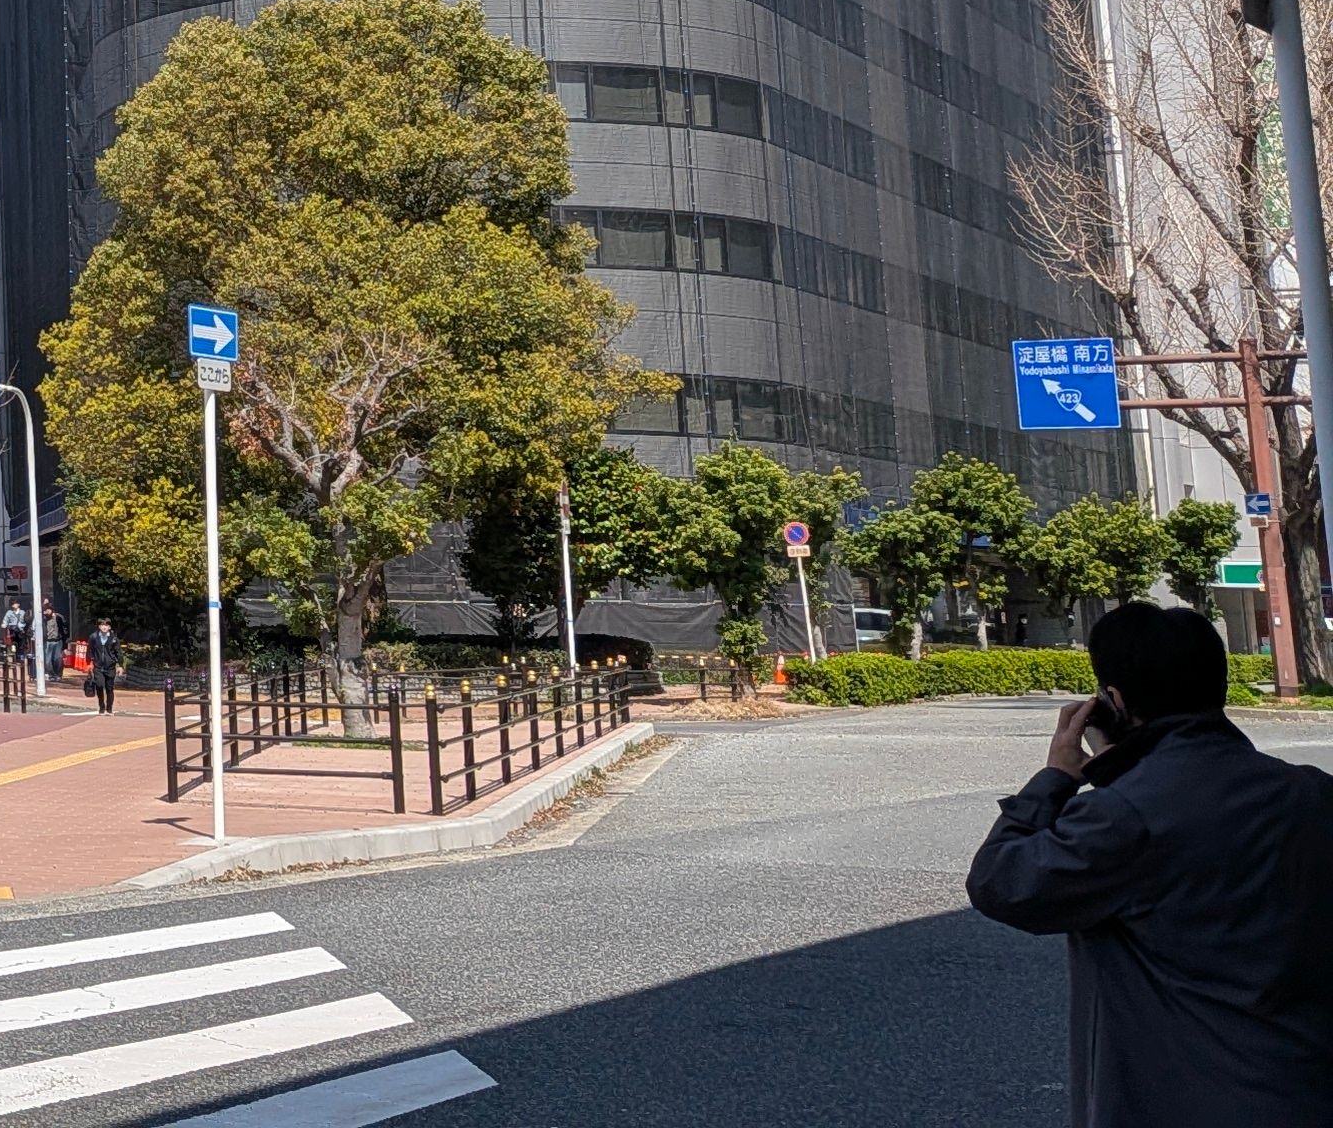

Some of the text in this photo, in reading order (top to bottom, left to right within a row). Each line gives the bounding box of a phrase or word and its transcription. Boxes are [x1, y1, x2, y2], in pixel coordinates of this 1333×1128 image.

[1018, 344, 1109, 364] 淀屋橋 南方
[200, 366, 230, 384] ここから
[1019, 365, 1070, 377] Yodoyabashi
[1060, 393, 1079, 404] 423
